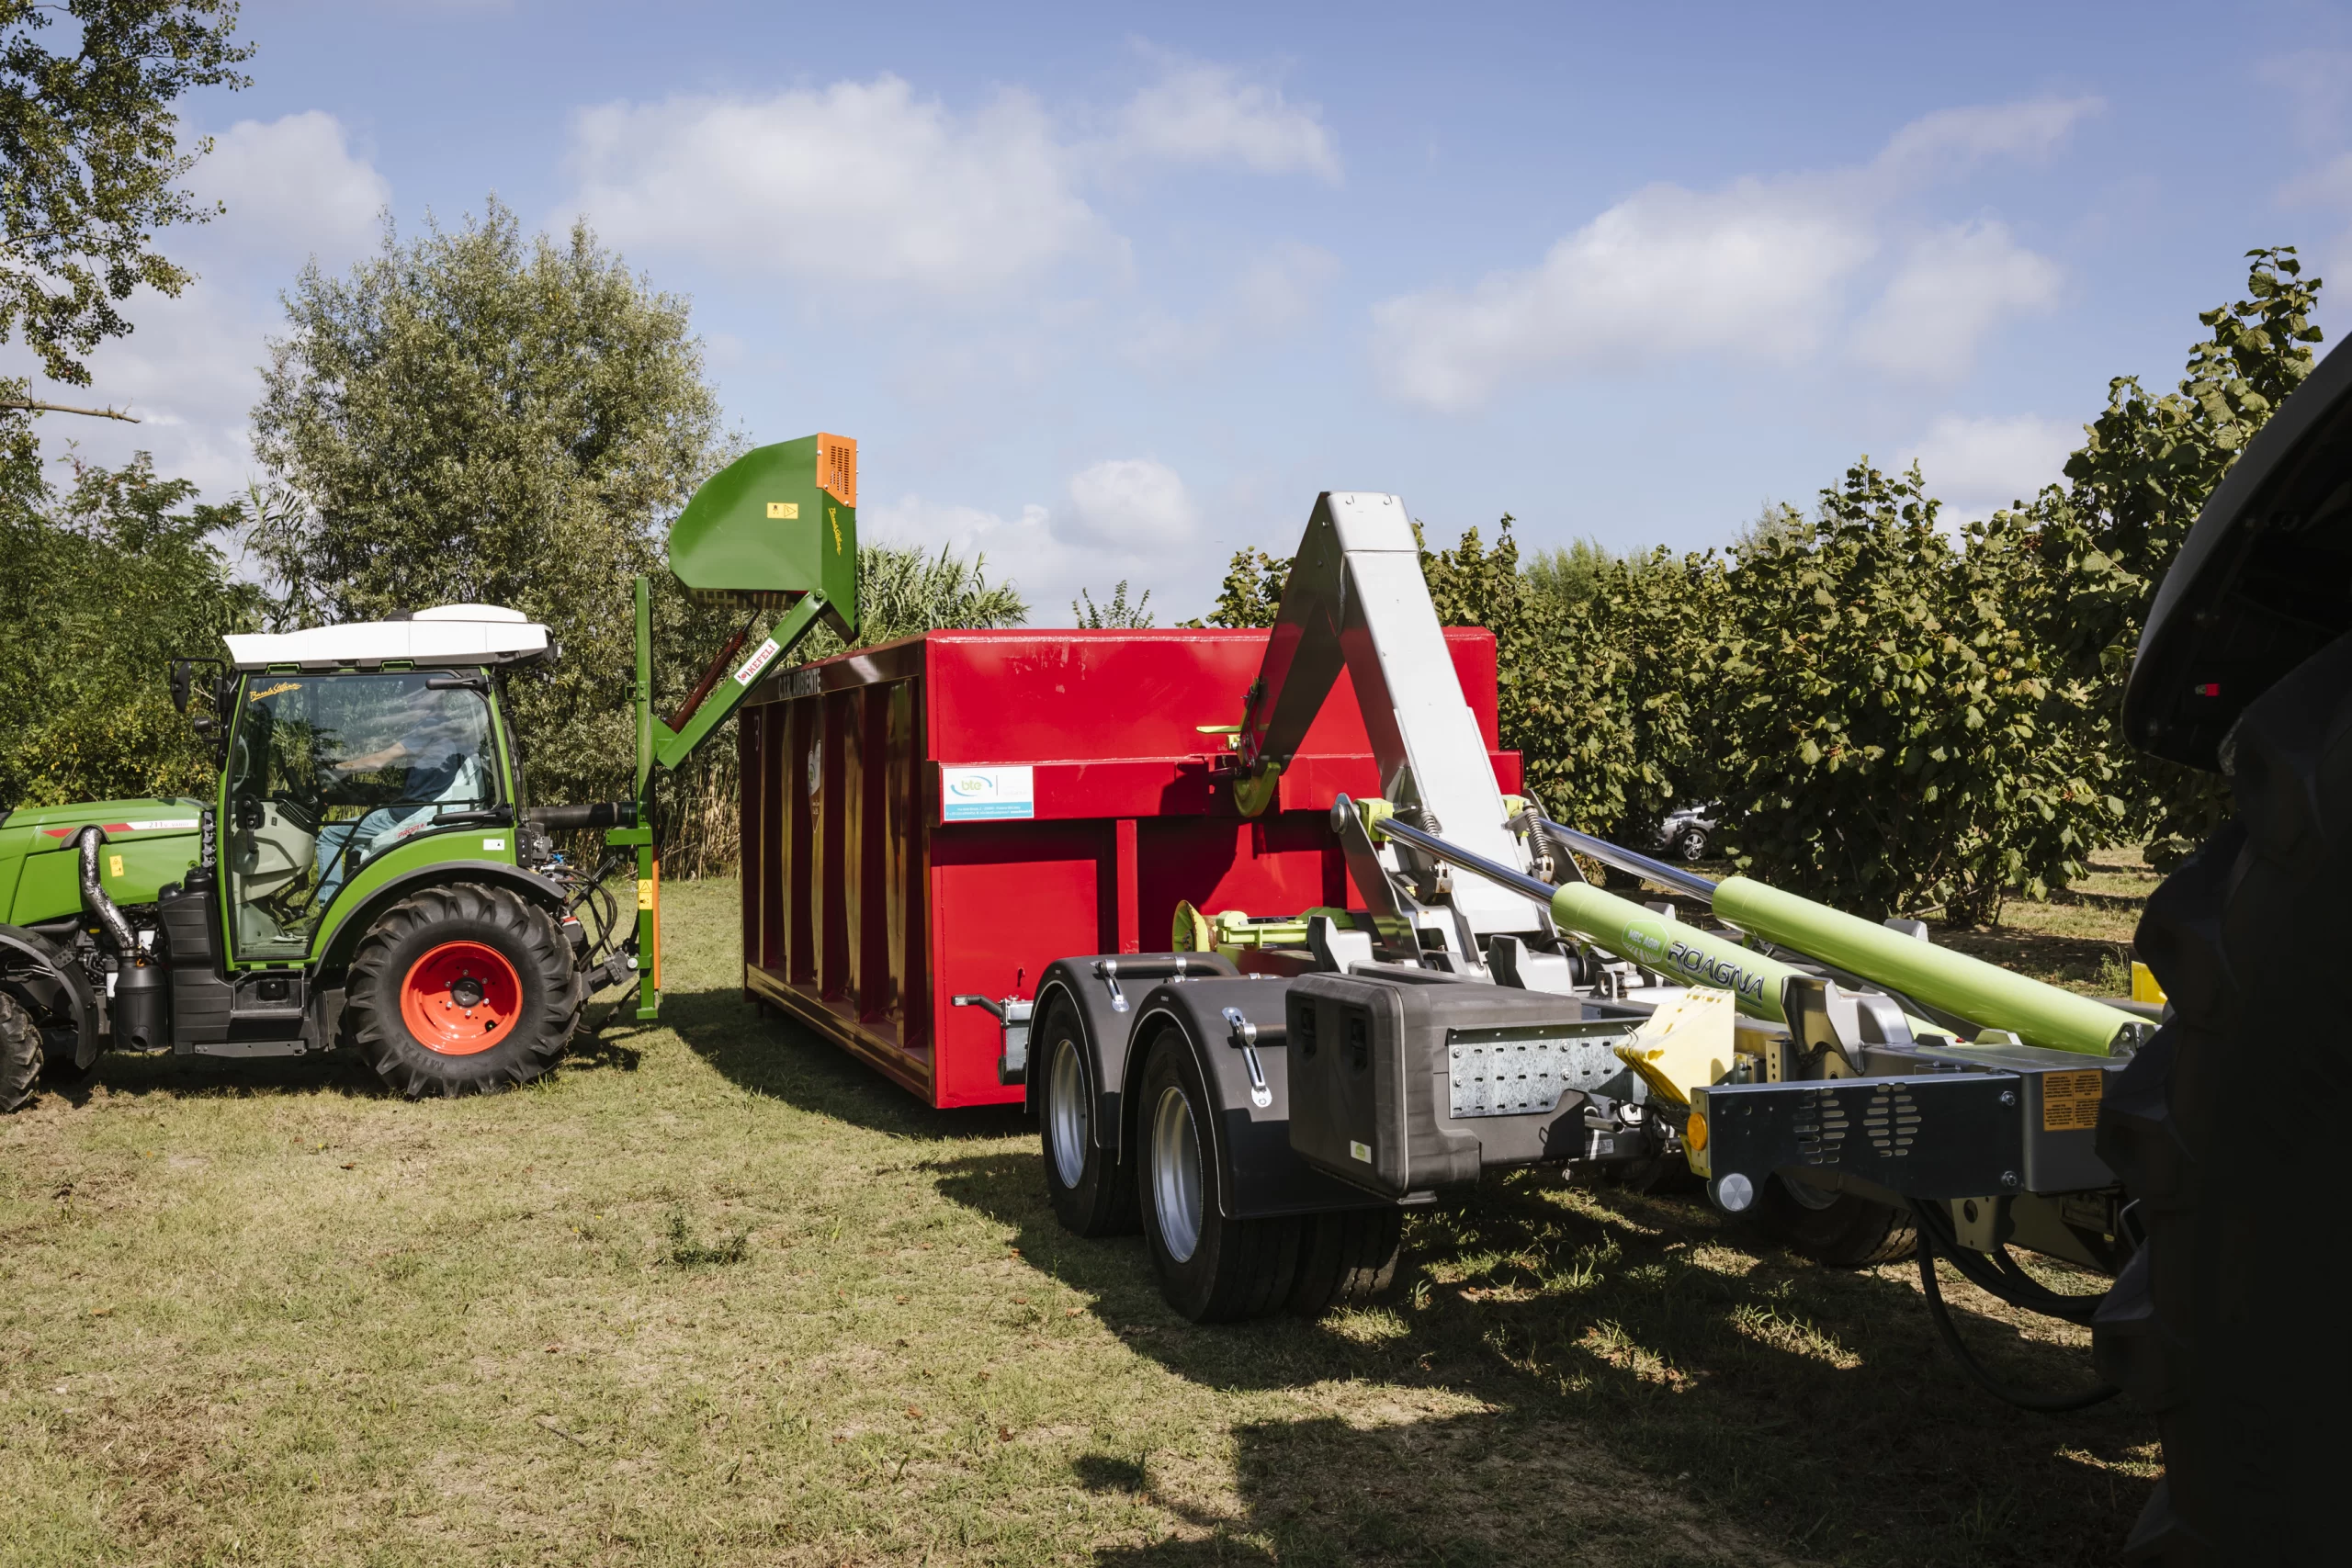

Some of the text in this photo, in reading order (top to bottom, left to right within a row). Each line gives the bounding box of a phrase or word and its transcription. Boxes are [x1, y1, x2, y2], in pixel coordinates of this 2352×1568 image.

[793, 668, 821, 697] AMBIENTE
[961, 780, 982, 791] bte
[1627, 929, 1661, 952] MEC AGRI
[1668, 940, 1765, 1001] ROAGNA
